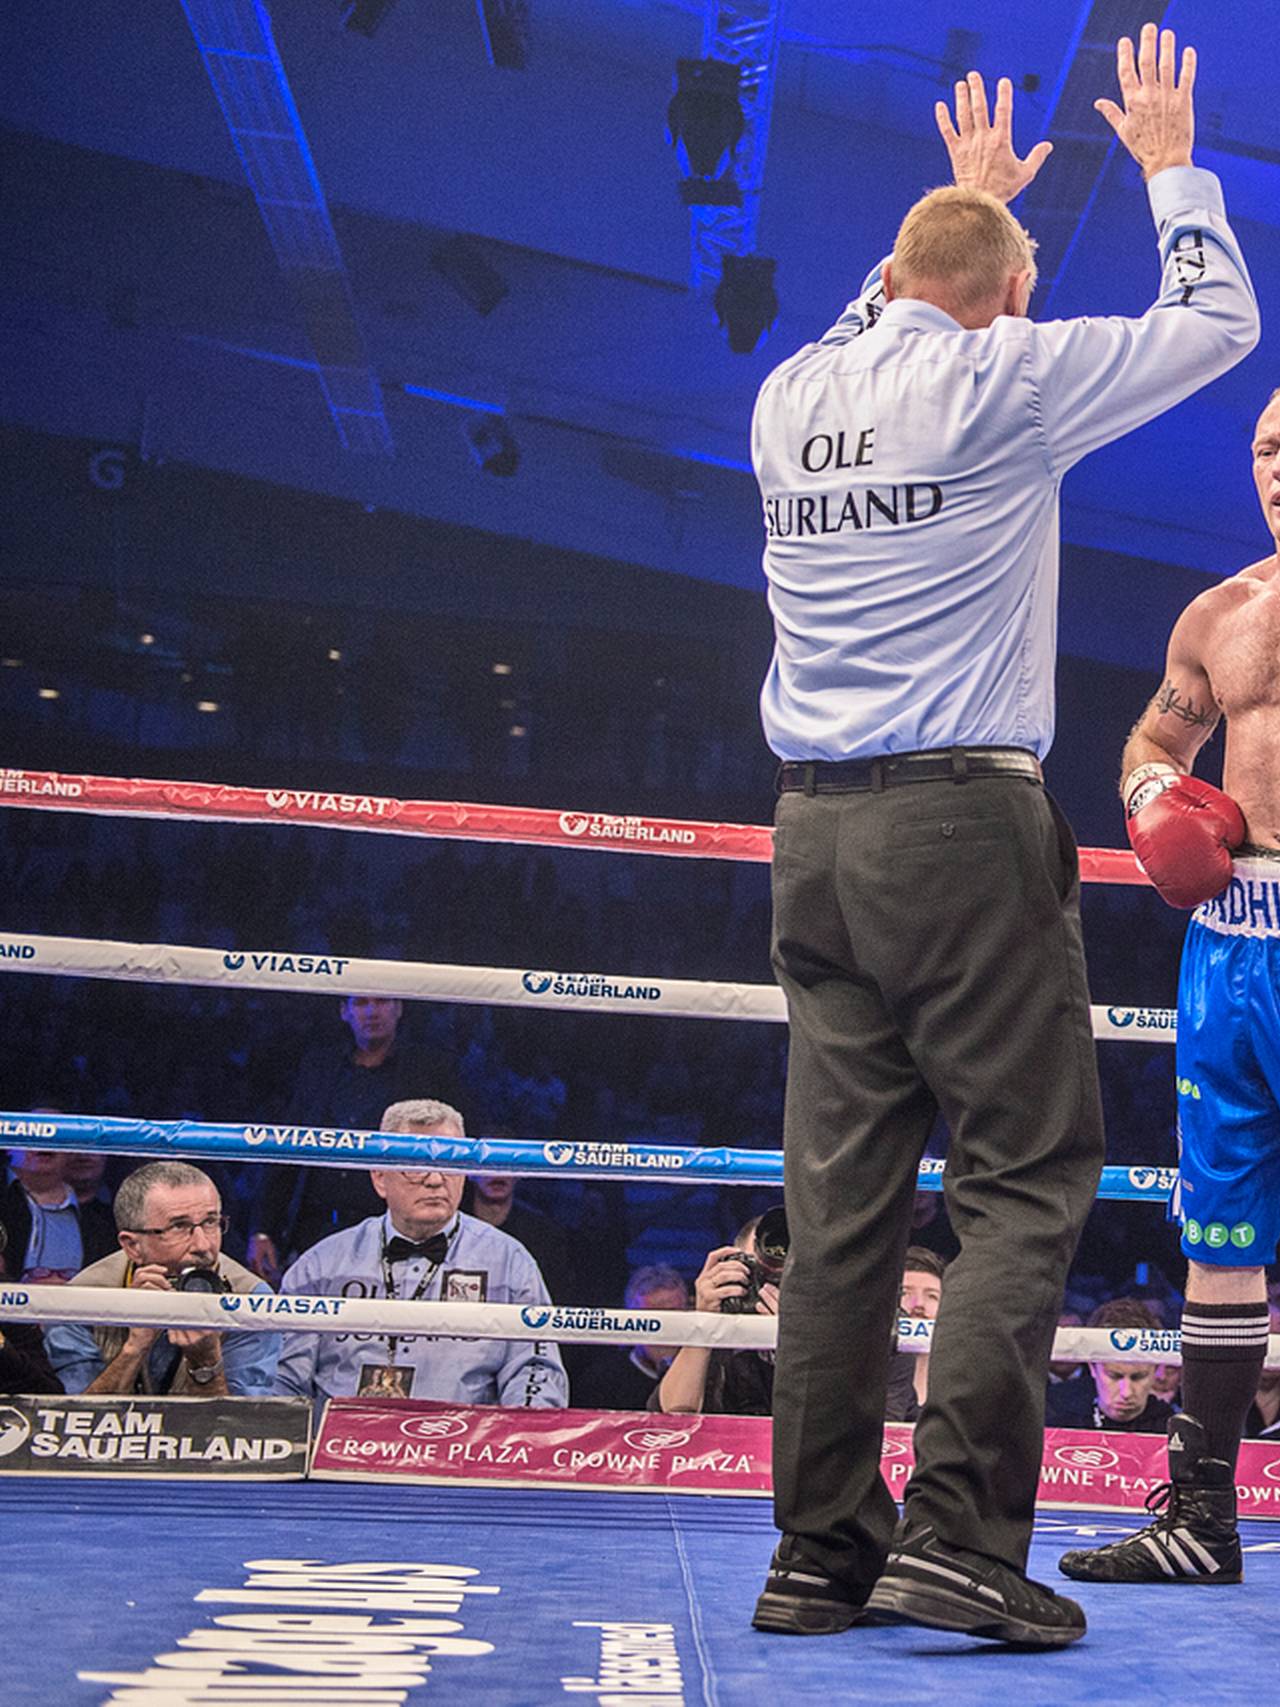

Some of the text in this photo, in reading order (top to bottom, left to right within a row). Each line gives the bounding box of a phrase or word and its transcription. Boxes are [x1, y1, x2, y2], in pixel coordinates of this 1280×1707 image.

[801, 428, 875, 473] OLE
[766, 483, 943, 537] SURLAND
[0, 778, 82, 797] ERLAND
[294, 792, 392, 816] VIASAT
[589, 822, 696, 845] SAUERLAND
[251, 957, 350, 977] VIASAT
[552, 980, 662, 1001] SAUERLAND
[273, 1126, 373, 1150] VIASAT
[573, 1150, 685, 1168] SAUERLAND
[248, 1296, 347, 1316] VIASAT
[550, 1314, 662, 1334] SAUERLAND
[38, 1410, 163, 1435] TEAM
[31, 1433, 293, 1461] SAUERLAND
[325, 1438, 529, 1464] CROWNE PLAZA
[552, 1449, 751, 1474] CROWNE PLAZA
[1105, 1474, 1164, 1492] PLAZ
